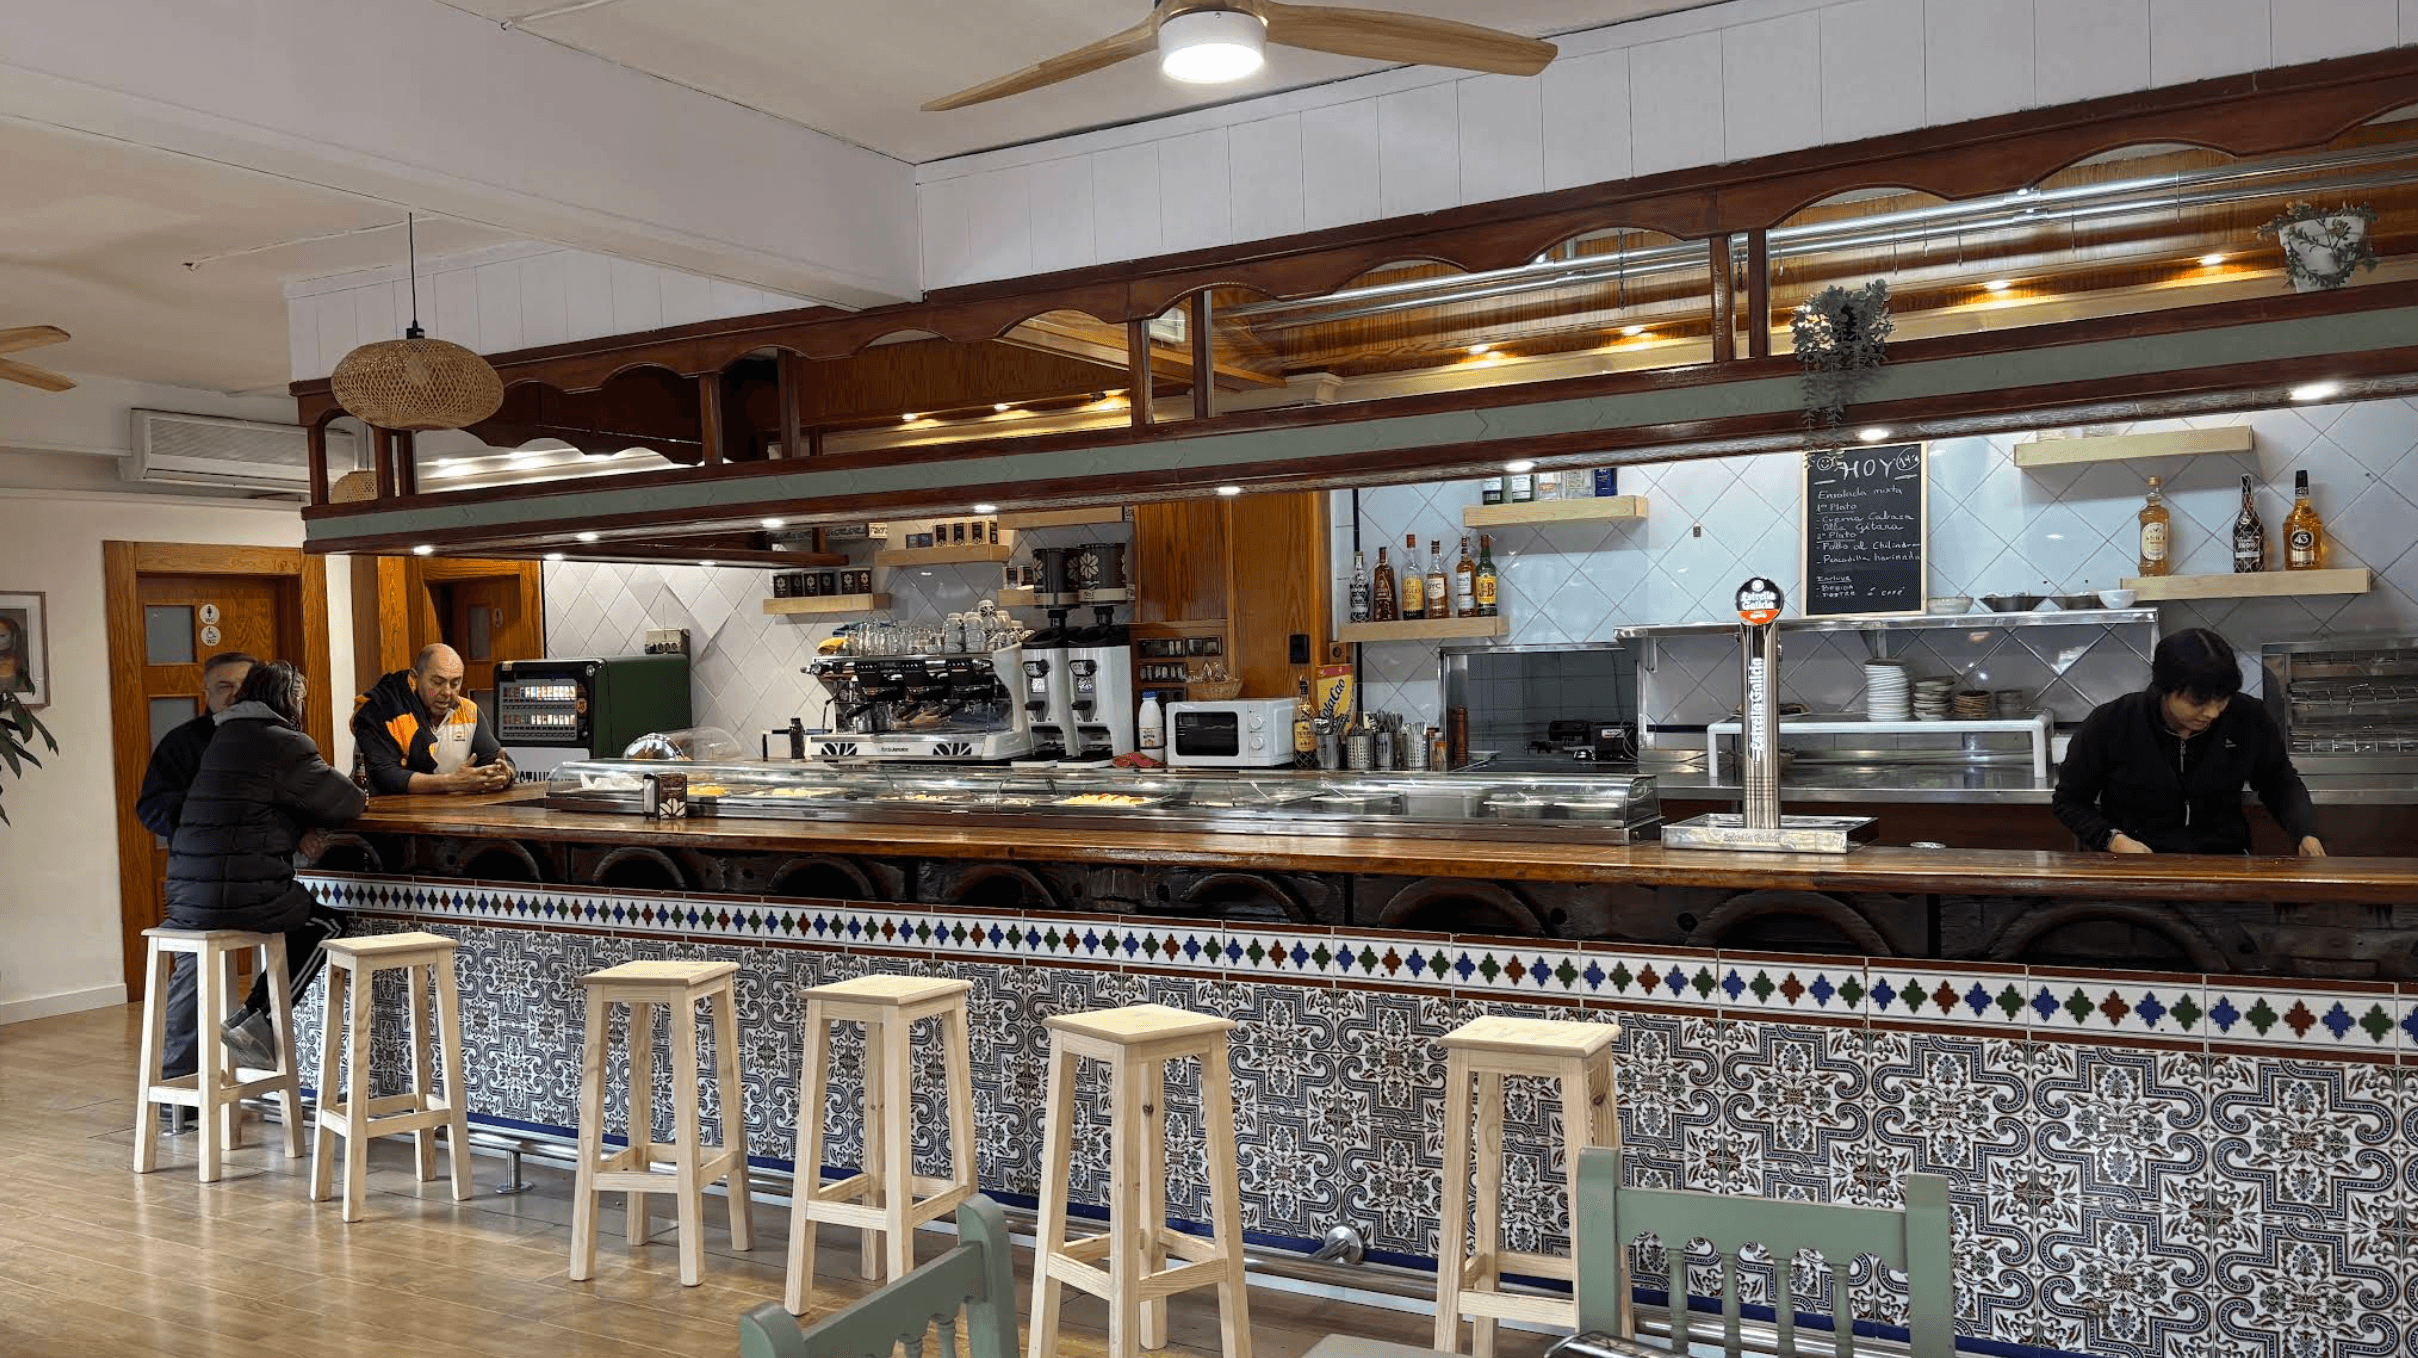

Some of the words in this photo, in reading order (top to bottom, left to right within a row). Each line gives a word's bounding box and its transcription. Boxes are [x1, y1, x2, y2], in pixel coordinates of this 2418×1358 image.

[1838, 458, 1897, 480] HOY
[1817, 487, 1867, 499] Ensalada
[1873, 485, 1903, 495] mixta
[1829, 502, 1857, 511] Plato
[1829, 531, 1857, 539] Plato
[2293, 534, 2310, 544] 43
[1822, 542, 1849, 550] Pollo
[1853, 541, 1868, 550] al
[1741, 600, 1775, 610] Galicia
[1321, 679, 1345, 719] olaCao
